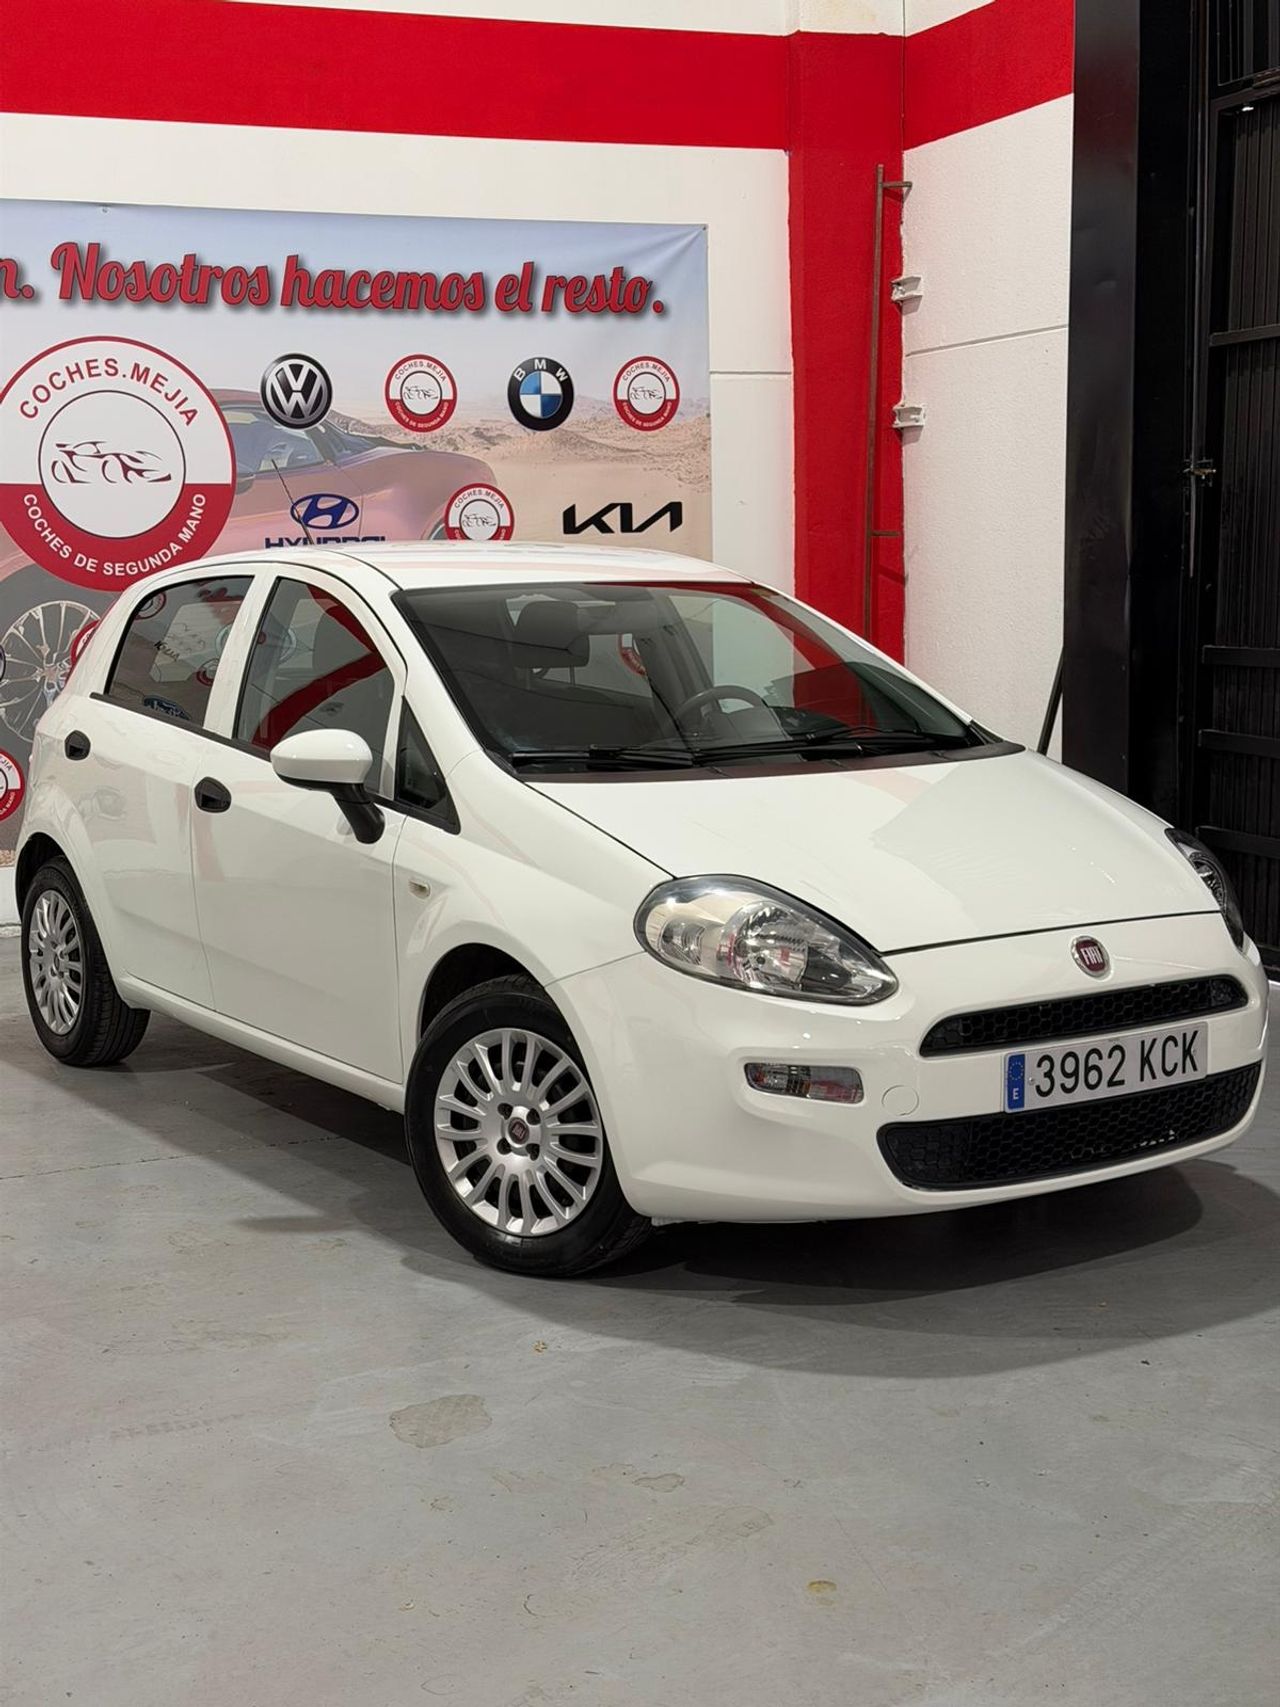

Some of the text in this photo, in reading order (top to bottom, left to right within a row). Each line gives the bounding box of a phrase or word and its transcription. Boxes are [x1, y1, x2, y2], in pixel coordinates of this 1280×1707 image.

[50, 241, 271, 306] Nosotros
[280, 254, 485, 312] hacemos
[494, 261, 535, 313] el
[541, 266, 665, 314] resto.
[19, 358, 199, 426] COCHES.MEJIA
[513, 358, 568, 382] BMW
[23, 493, 207, 577] COCHES DE SEGUNDA MANO
[562, 501, 683, 534] KIA
[1012, 1030, 1199, 1100] E 3962 KCK
